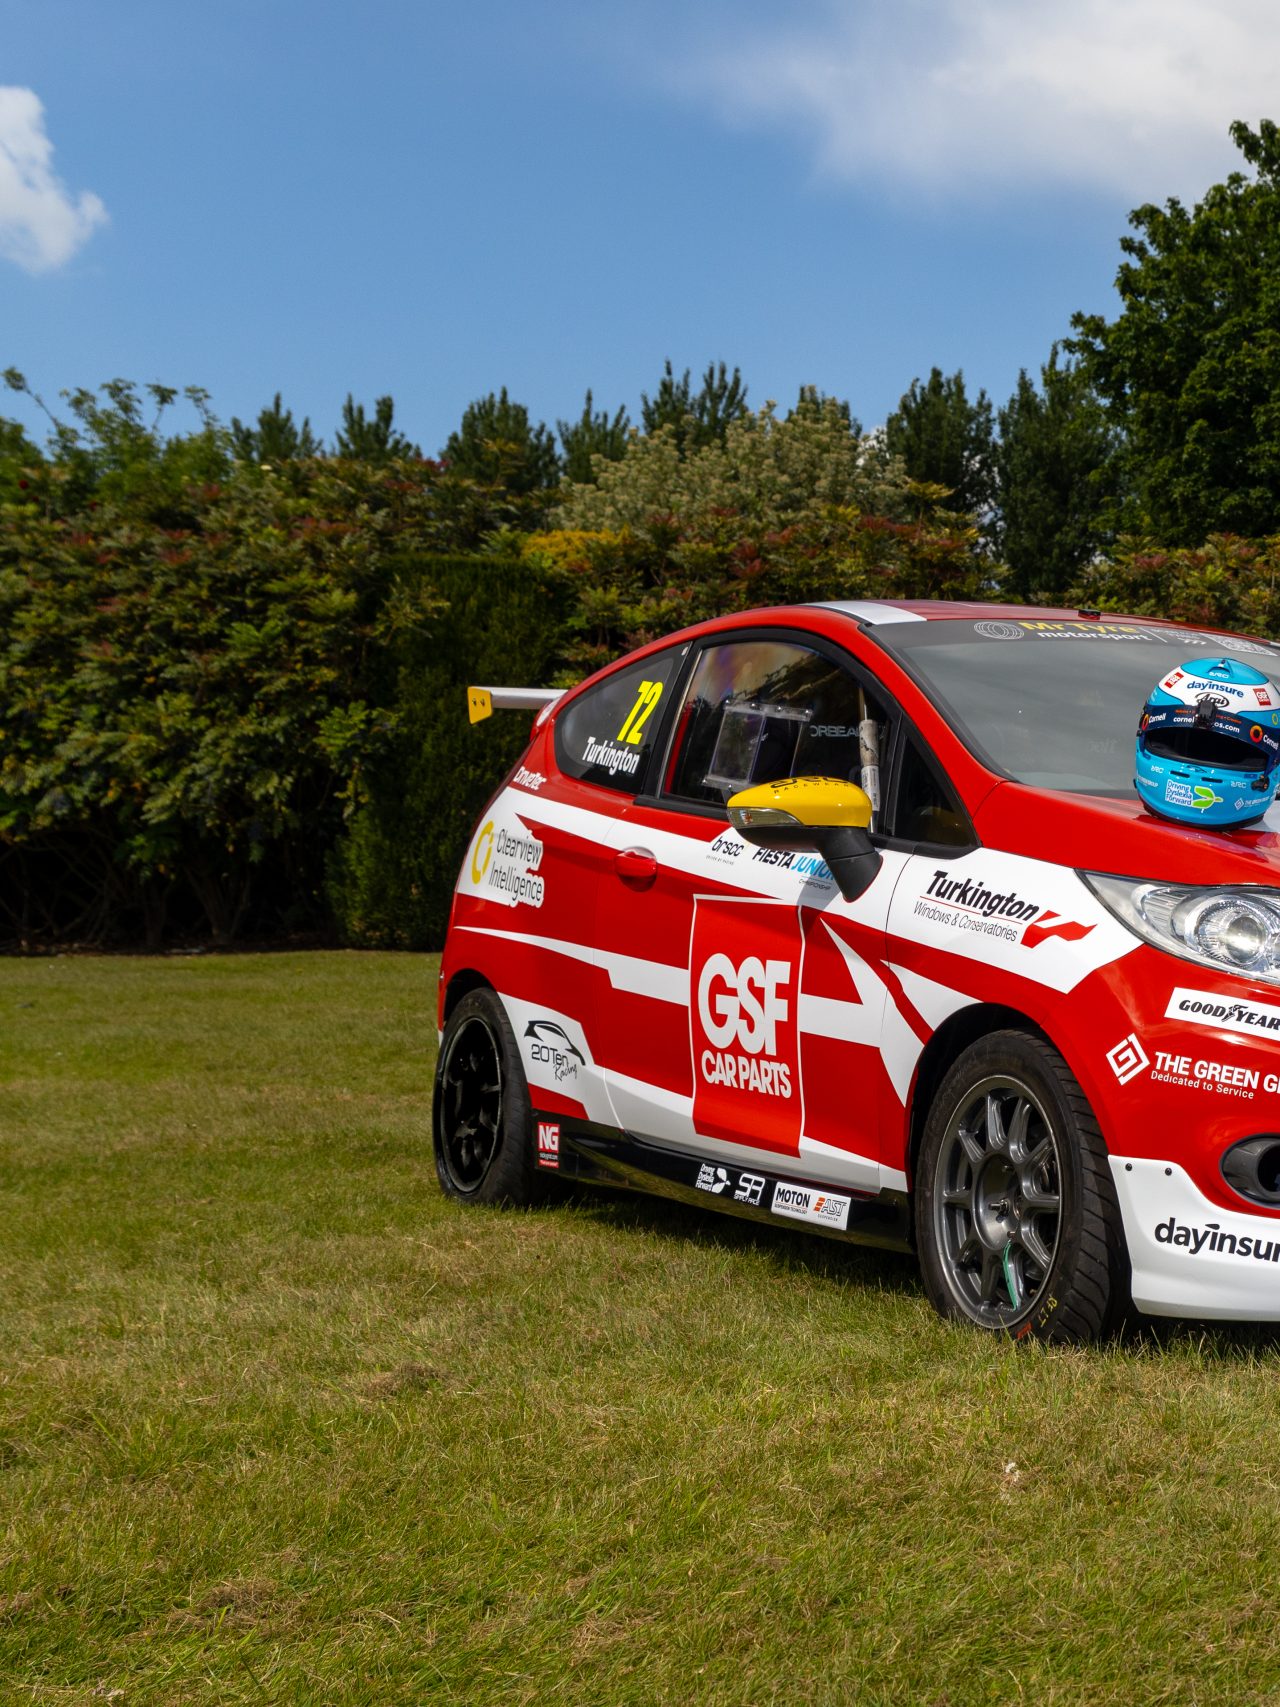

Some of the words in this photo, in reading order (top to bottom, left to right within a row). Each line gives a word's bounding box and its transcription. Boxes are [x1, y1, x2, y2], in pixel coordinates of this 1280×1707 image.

[1018, 622, 1065, 631] Mr
[1066, 622, 1138, 634] Tyre
[1037, 631, 1153, 641] motorsport
[1186, 680, 1245, 698] dayinsure
[581, 736, 640, 776] Turkington
[1166, 787, 1193, 800] Dyslexia
[1167, 780, 1190, 793] Driving
[1166, 793, 1192, 806] Forward
[496, 828, 542, 865] Clearview
[711, 835, 745, 857] brscc
[752, 847, 796, 869] FIESTA
[488, 860, 543, 902] Intelligence
[925, 869, 1040, 921] Turkington
[913, 900, 951, 925] Windows
[950, 914, 958, 926] &
[958, 914, 1018, 943] Conservatories
[697, 952, 792, 1056] GSF
[530, 1043, 570, 1068] 20Ten
[553, 1062, 578, 1082] Racing
[701, 1049, 739, 1089] CAR
[737, 1055, 793, 1099] PARTS
[1154, 1051, 1193, 1076] THE
[1193, 1060, 1261, 1090] GREEN
[1150, 1069, 1201, 1089] Dedicated
[1202, 1080, 1214, 1092] to
[1216, 1083, 1255, 1101] Service
[538, 1125, 560, 1151] NG
[775, 1188, 811, 1208] MOTON
